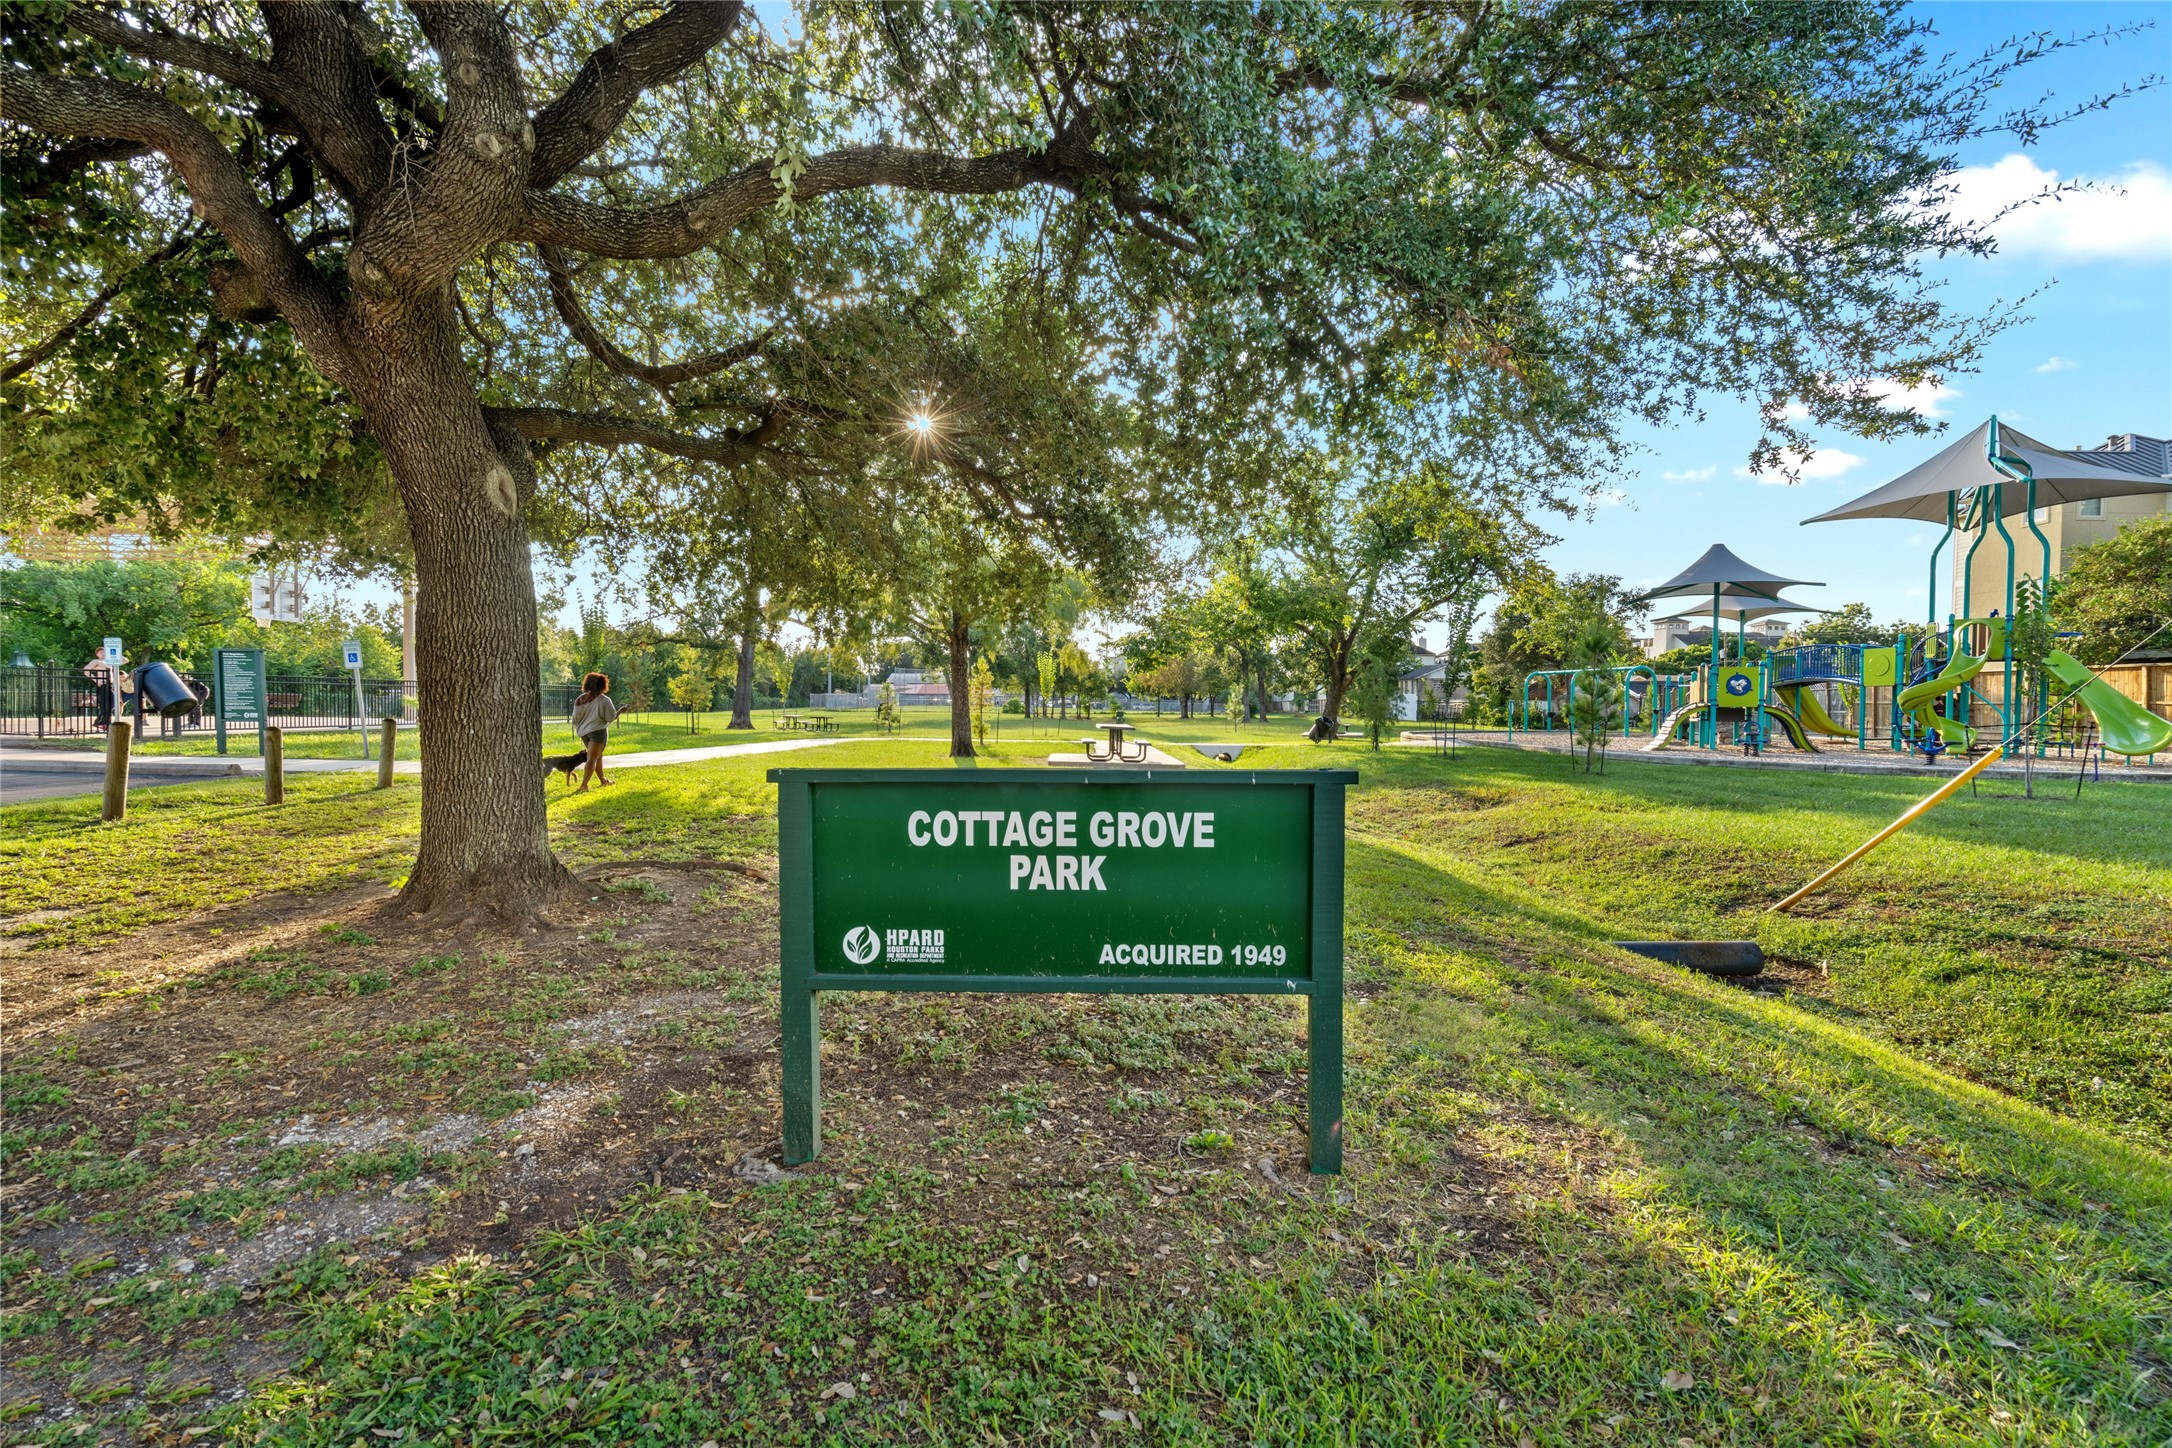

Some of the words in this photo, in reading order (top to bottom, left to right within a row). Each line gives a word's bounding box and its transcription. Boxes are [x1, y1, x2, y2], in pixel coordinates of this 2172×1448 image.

[908, 811, 1076, 847] COTTAGE
[1090, 811, 1214, 848] GROVE
[1010, 855, 1106, 890] PARK
[886, 929, 944, 946] HPARD
[1099, 944, 1222, 966] ACQUIRED
[1231, 944, 1287, 966] 1949
